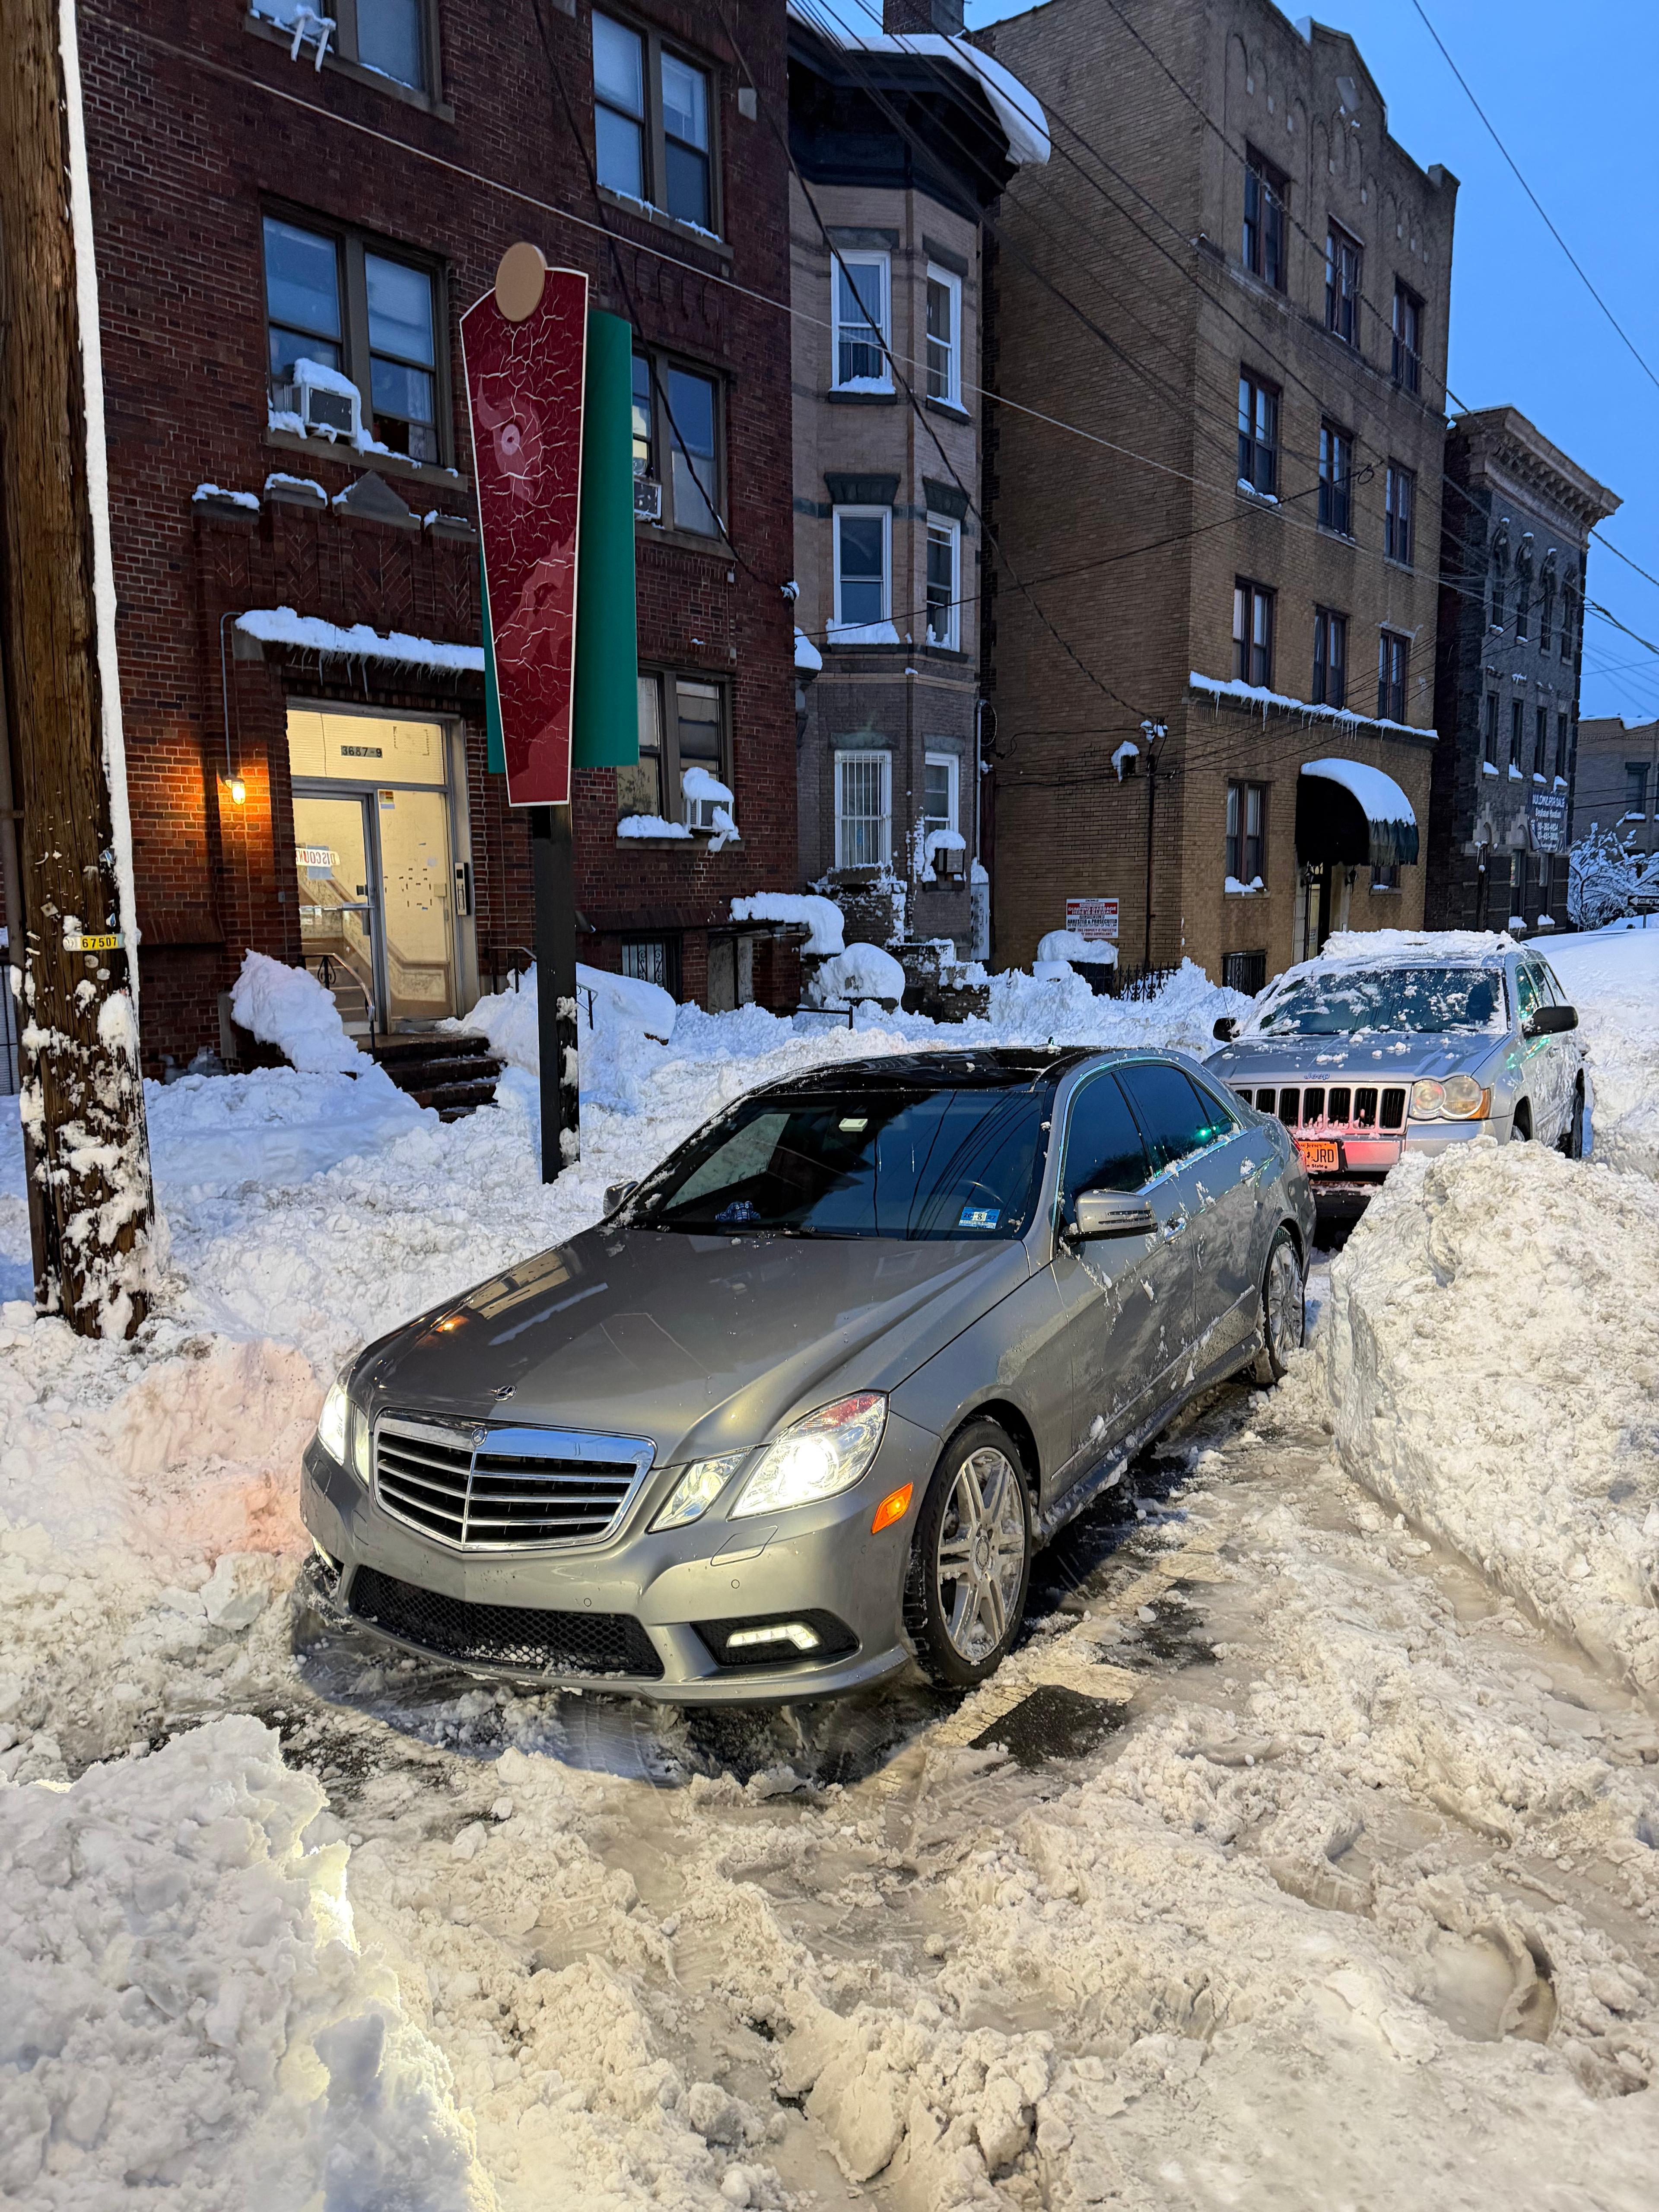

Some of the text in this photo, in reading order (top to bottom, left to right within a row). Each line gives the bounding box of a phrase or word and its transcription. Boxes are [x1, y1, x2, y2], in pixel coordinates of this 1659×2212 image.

[342, 746, 382, 757] 3687-9
[82, 937, 117, 948] 67507
[1304, 1072, 1330, 1081] Jeep
[1312, 1149, 1334, 1163] JRD
